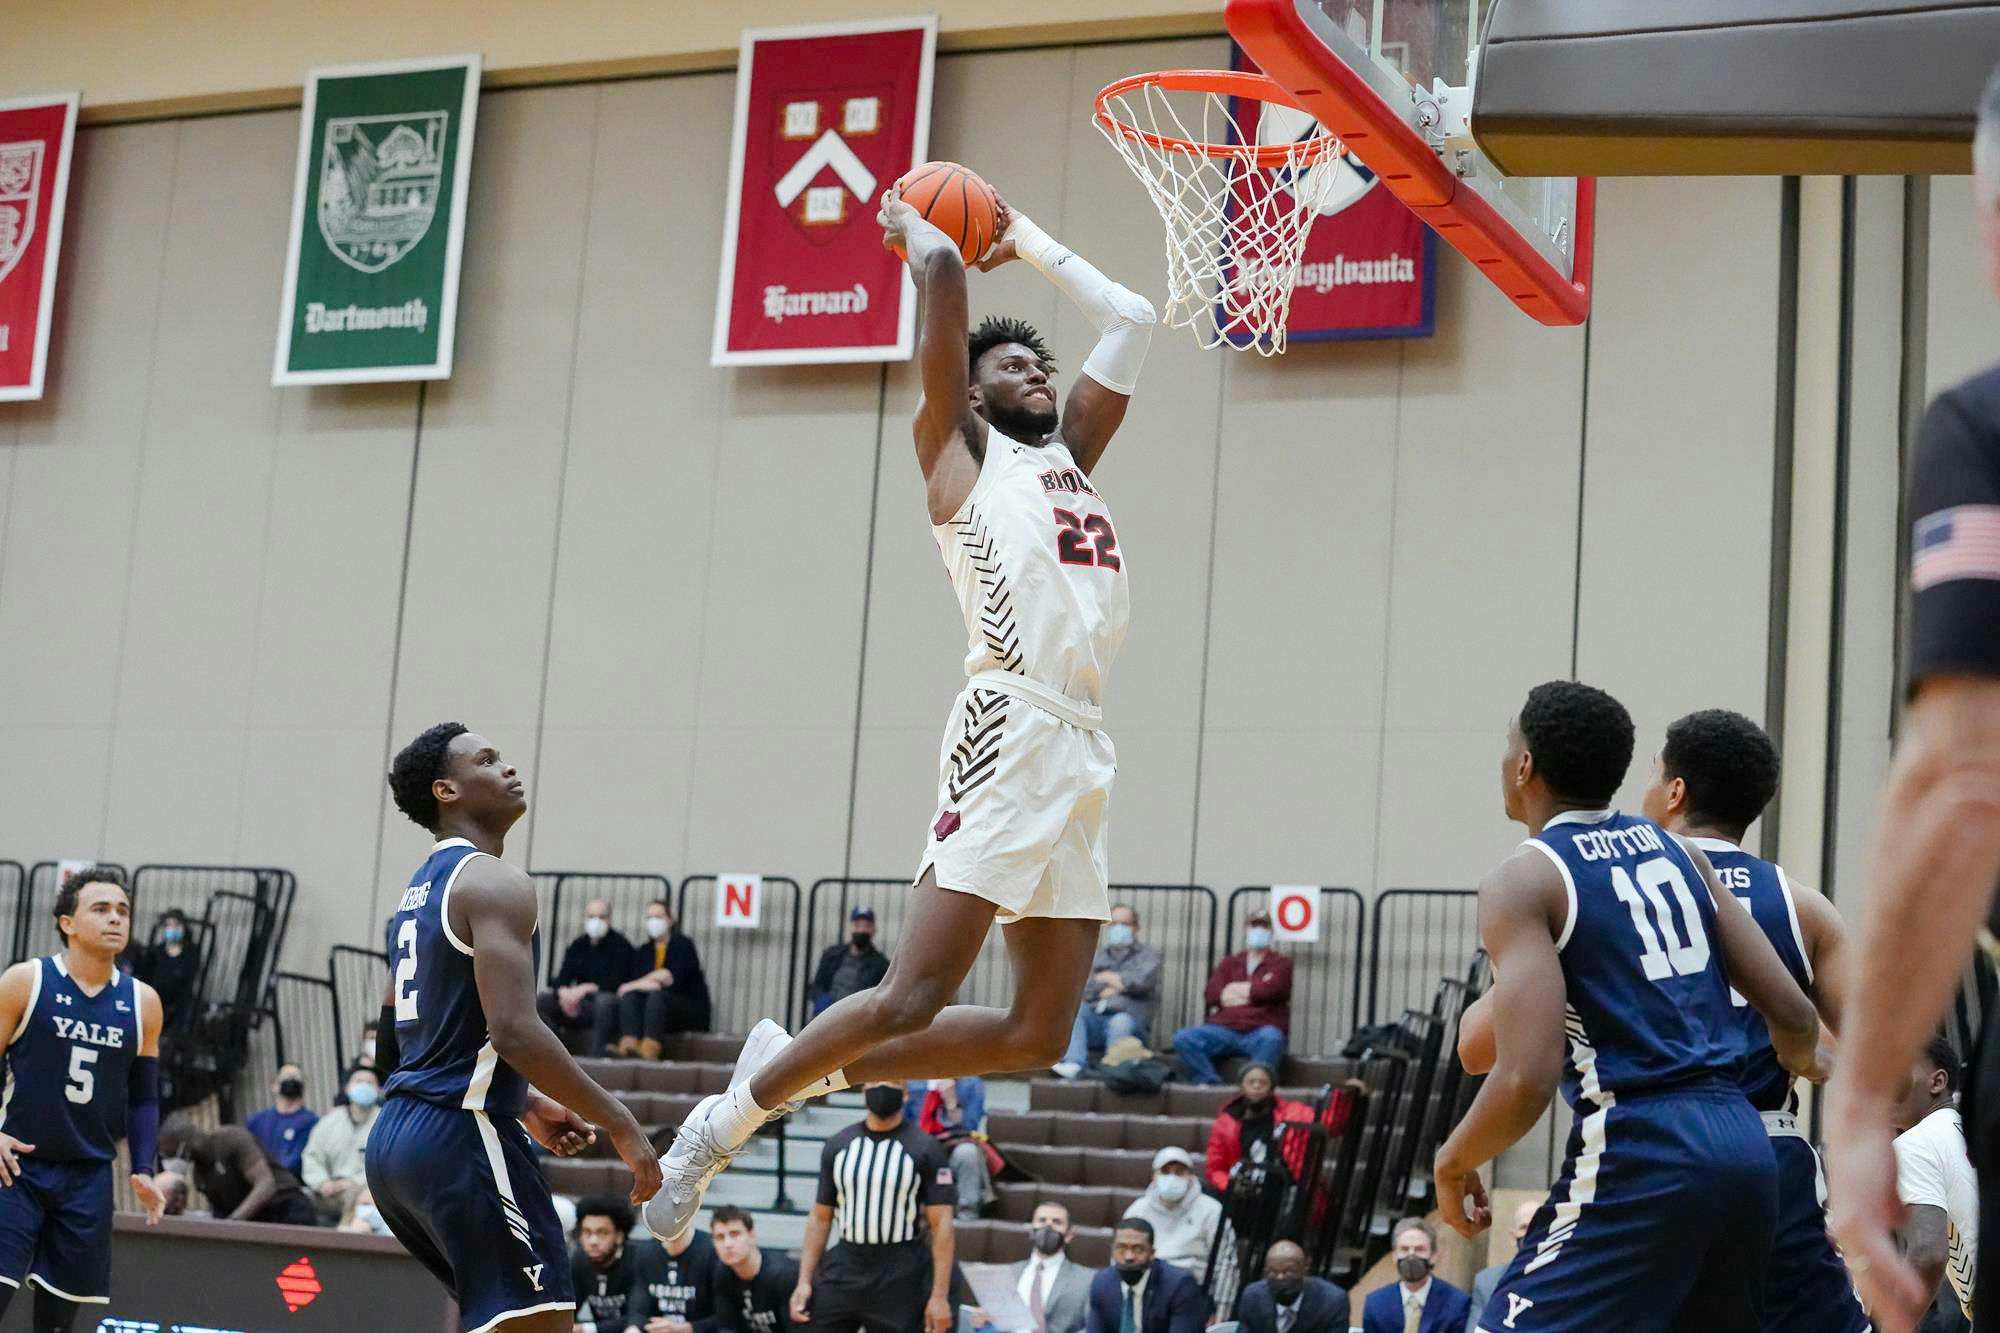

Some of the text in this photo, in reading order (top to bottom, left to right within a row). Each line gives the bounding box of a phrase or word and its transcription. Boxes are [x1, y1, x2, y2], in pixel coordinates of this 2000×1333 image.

[305, 299, 428, 333] Dartmouth
[763, 283, 869, 323] Harvard
[1053, 507, 1120, 573] 22
[1572, 824, 1665, 862] COTTON
[725, 883, 752, 917] N
[1278, 895, 1312, 931] O
[1610, 857, 1711, 981] 10
[394, 918, 419, 1022] 2
[51, 1015, 125, 1049] YALE
[64, 1045, 99, 1105] 5
[522, 1263, 544, 1292] Y
[1502, 1292, 1534, 1329] Y
